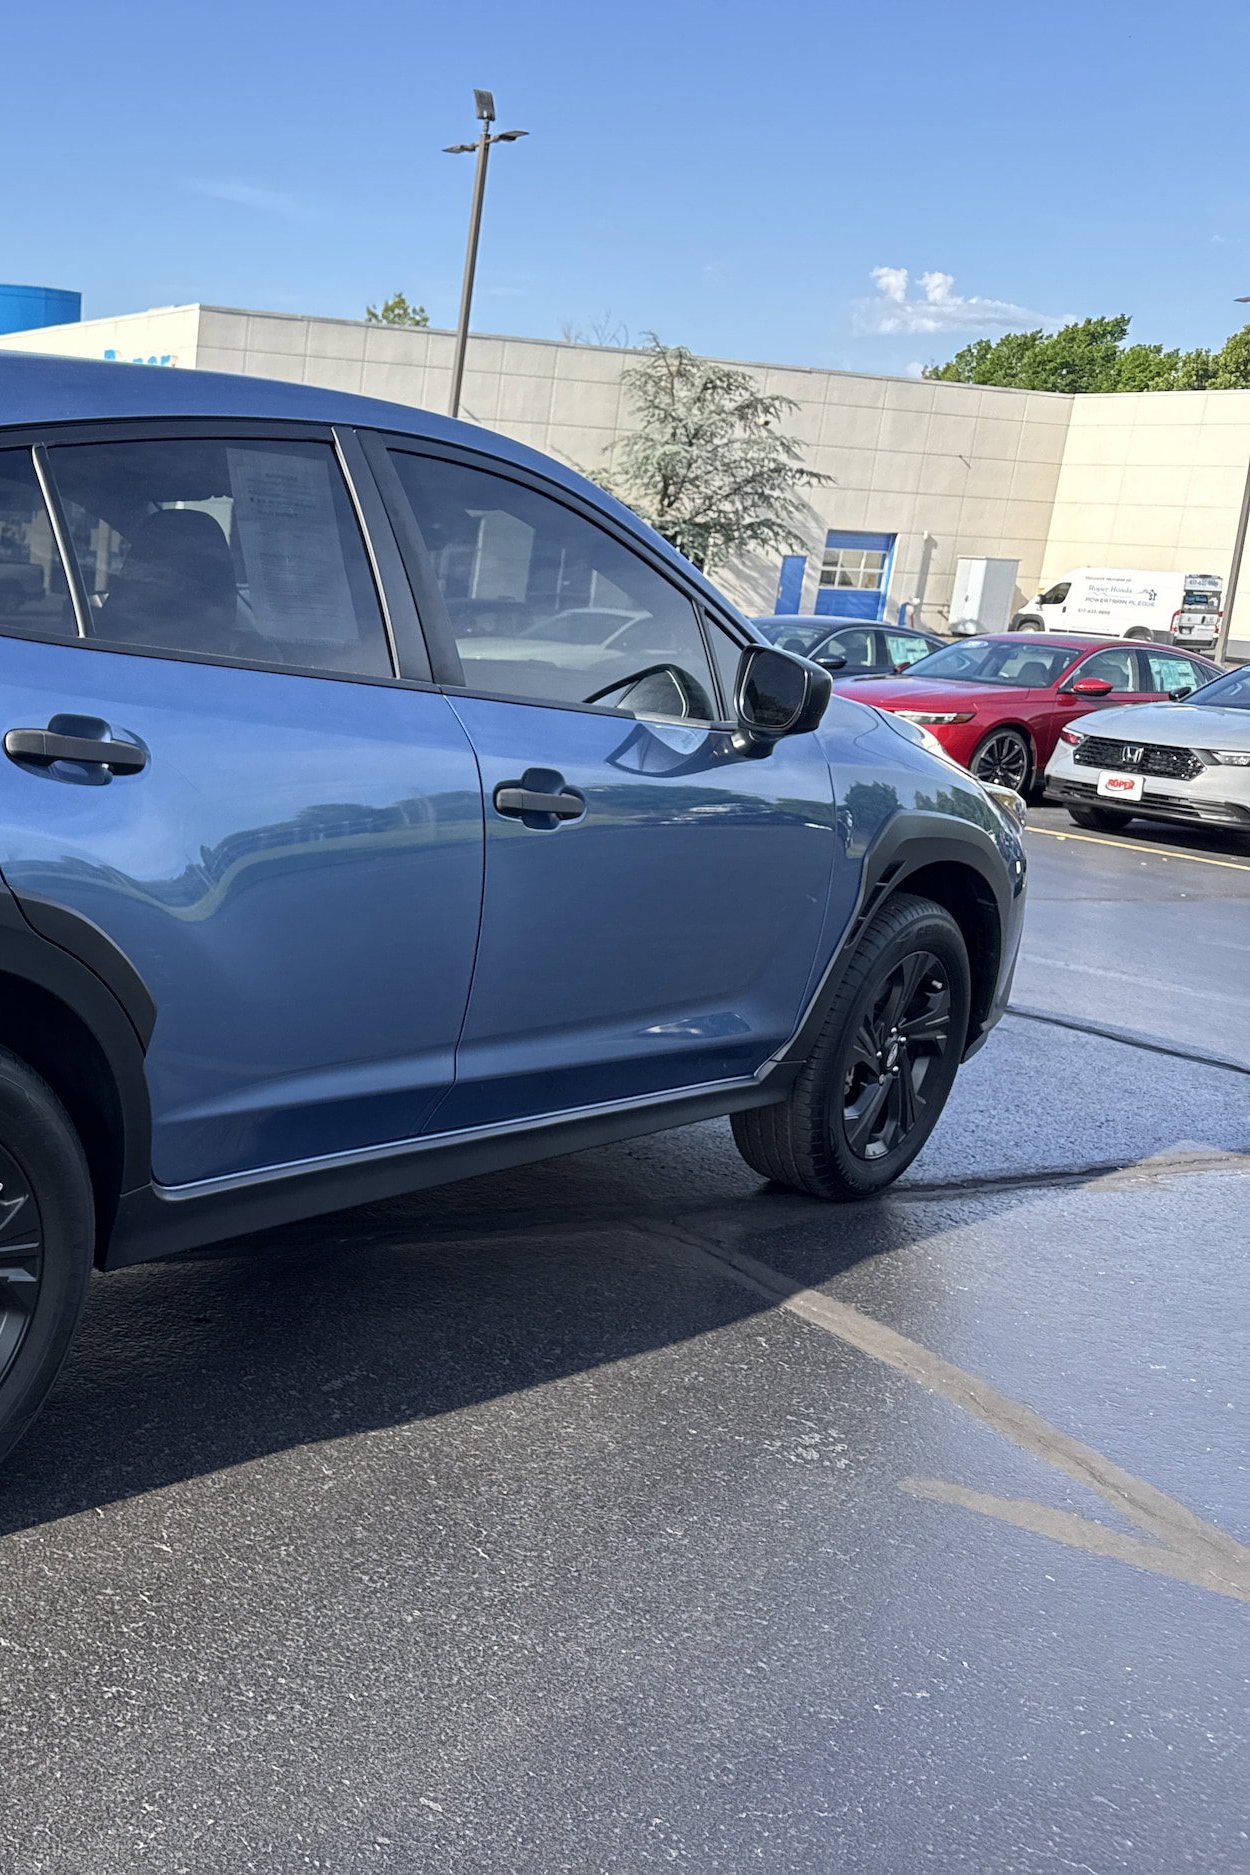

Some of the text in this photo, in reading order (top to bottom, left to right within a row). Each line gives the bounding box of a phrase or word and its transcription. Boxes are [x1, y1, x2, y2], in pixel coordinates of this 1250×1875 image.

[1089, 584, 1133, 594] Roper Honda
[1107, 779, 1135, 791] ROPER
